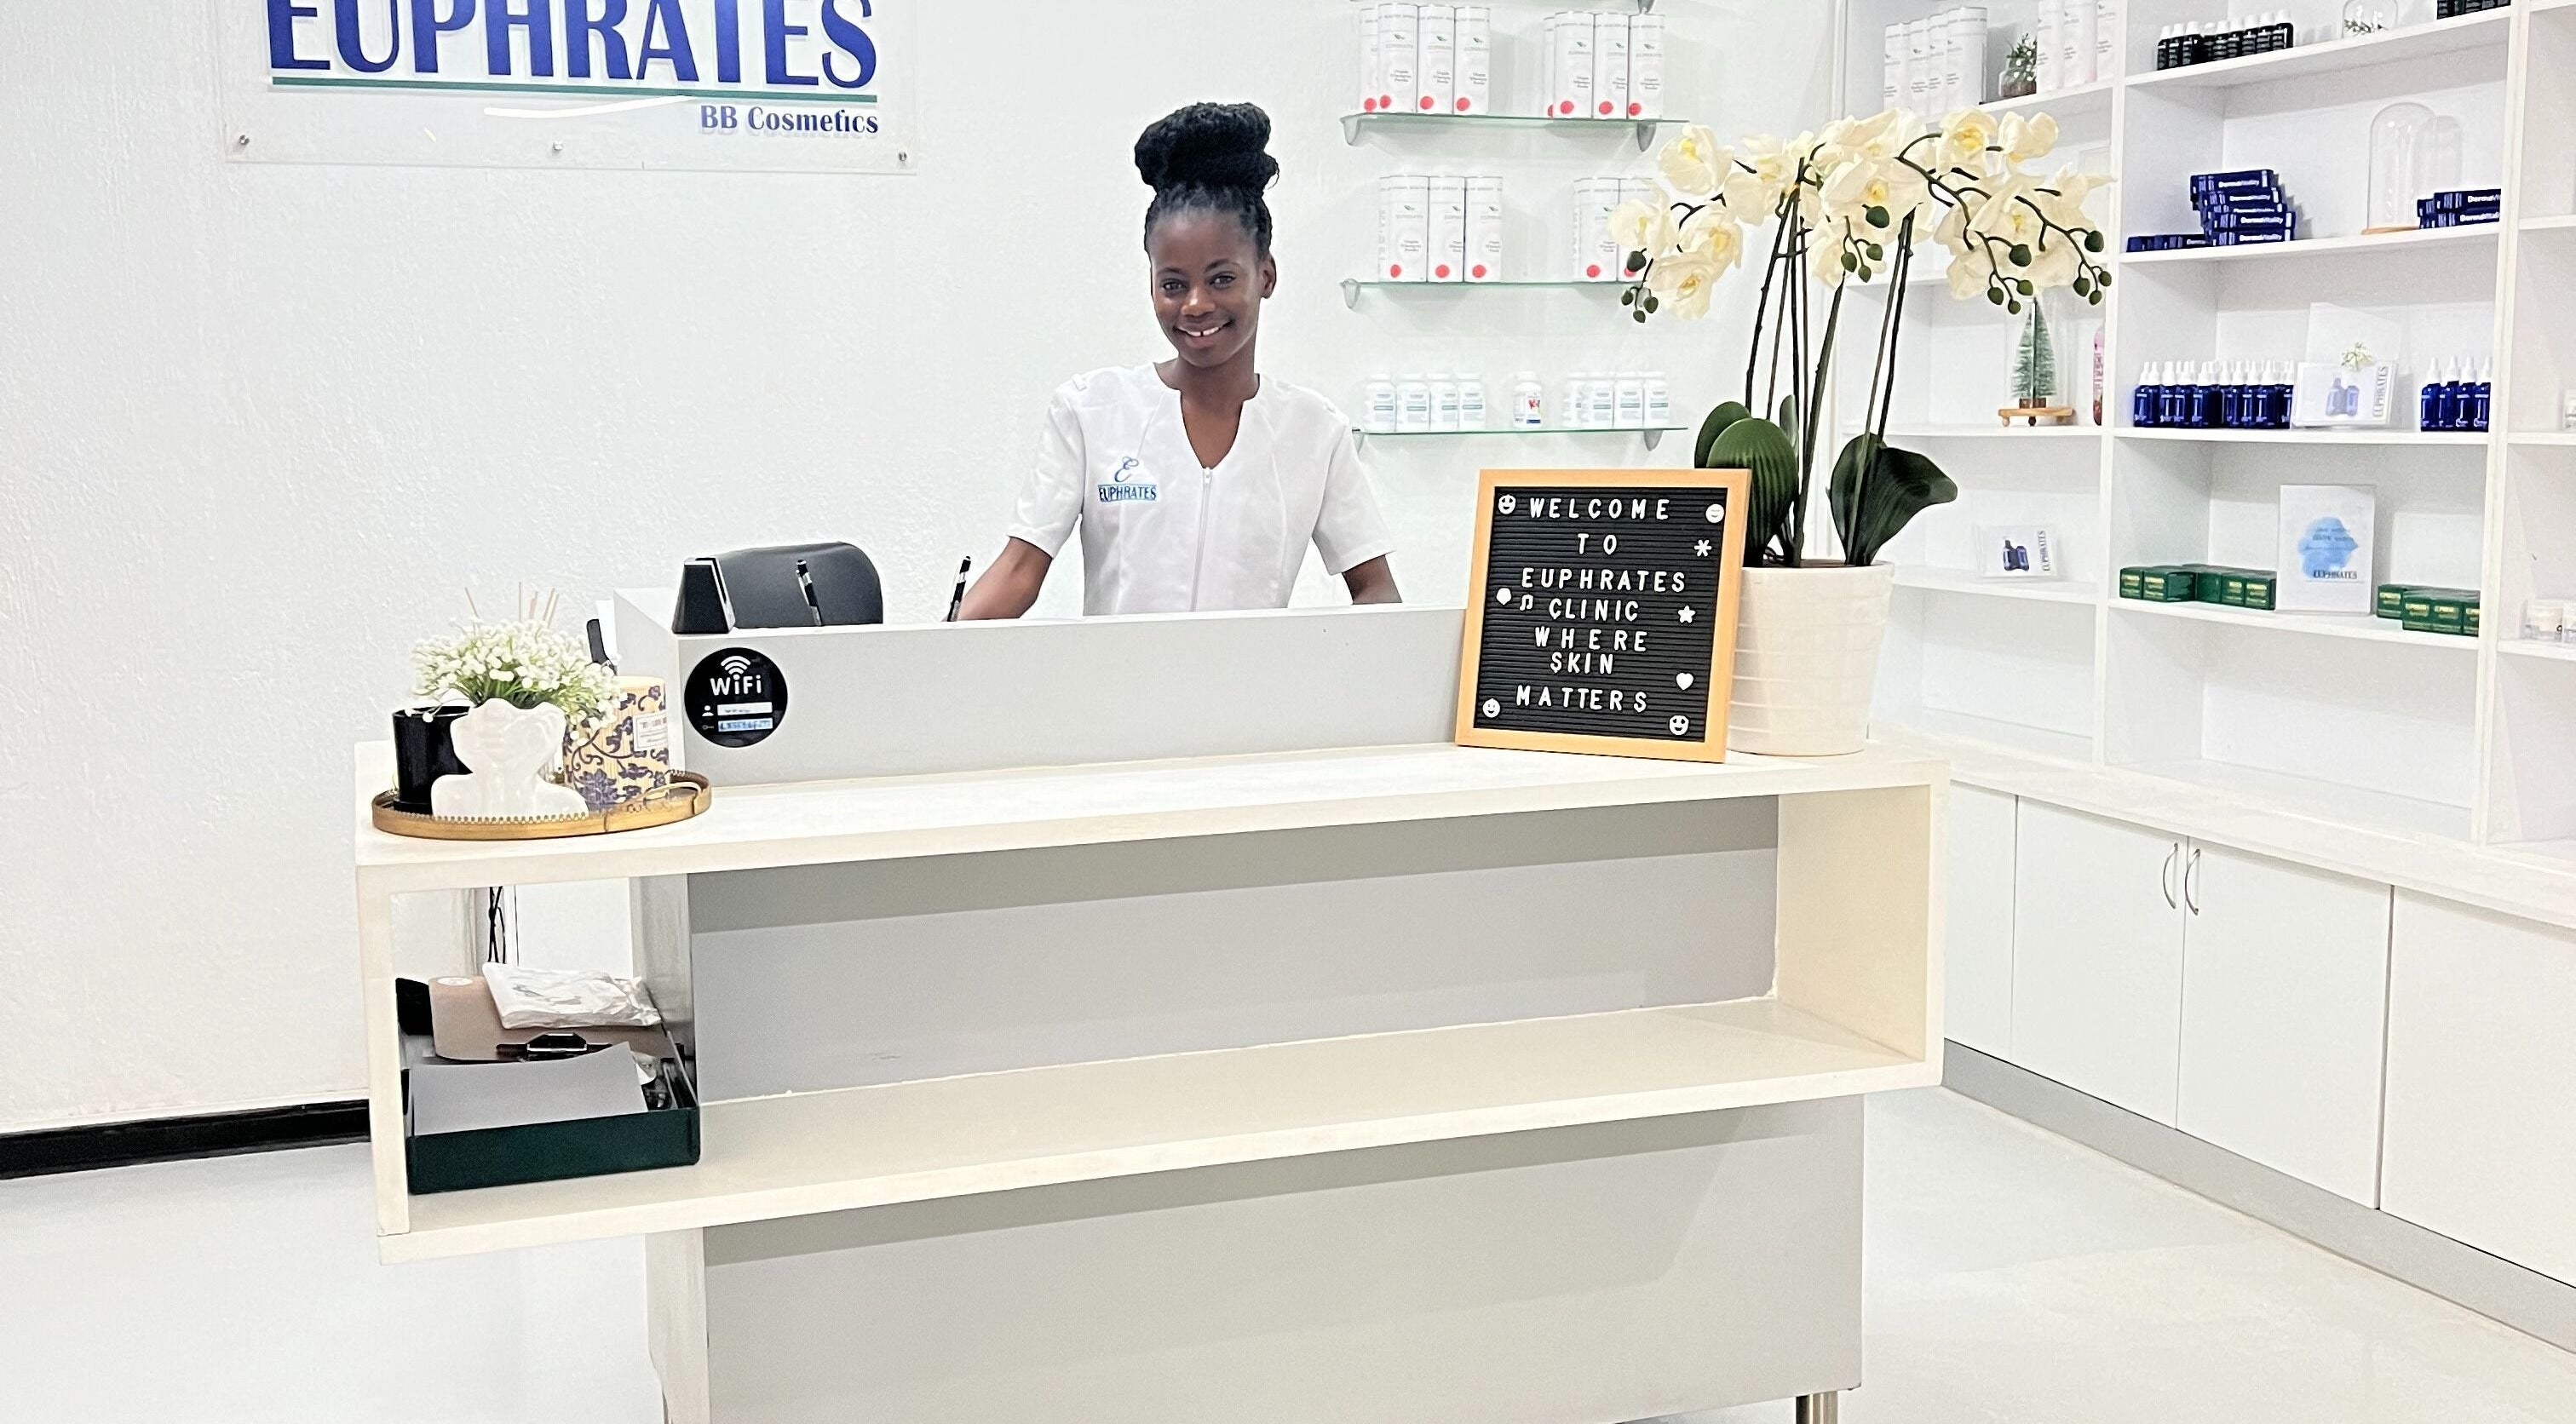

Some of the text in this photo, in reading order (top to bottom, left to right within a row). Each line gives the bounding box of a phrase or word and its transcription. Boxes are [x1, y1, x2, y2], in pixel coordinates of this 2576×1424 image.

[267, 0, 877, 88] EUPHRATES
[700, 105, 878, 134] BB Cosmetics
[1098, 485, 1157, 502] EUPHRATES
[1529, 497, 1670, 520] WELCOME
[1578, 532, 1618, 555] TO
[1521, 567, 1686, 593] EUPHRATES
[1548, 598, 1639, 622] CLINIC
[1534, 626, 1647, 652] WHERE
[1550, 652, 1614, 674] SKIN
[710, 674, 762, 696] WiFi
[1515, 685, 1647, 713] MATTERS
